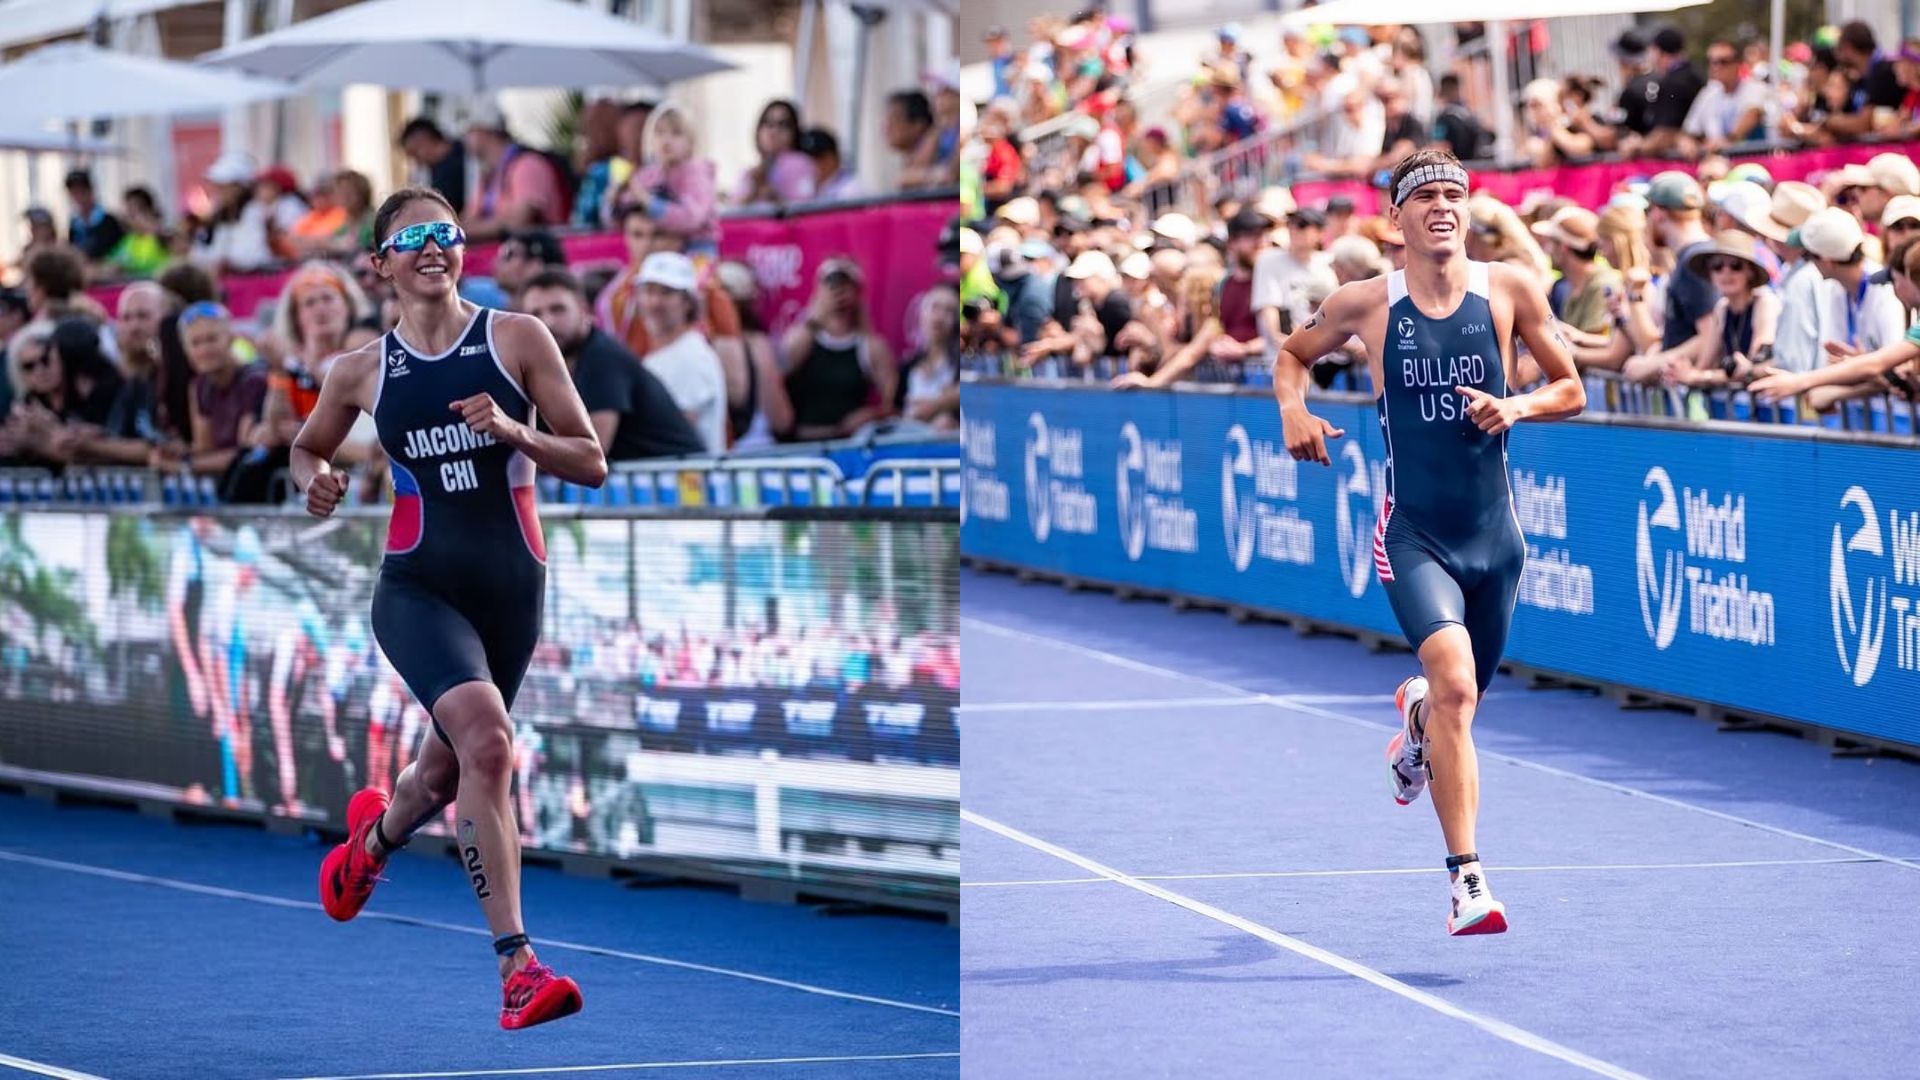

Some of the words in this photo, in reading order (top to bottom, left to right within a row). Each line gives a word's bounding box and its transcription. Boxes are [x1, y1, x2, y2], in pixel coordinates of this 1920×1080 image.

[1403, 354, 1485, 387] BULLARD
[440, 459, 479, 493] CHI
[1513, 467, 1567, 540] World
[1684, 486, 1746, 563] World
[1685, 566, 1775, 647] Triathlon
[465, 846, 491, 898] 22
